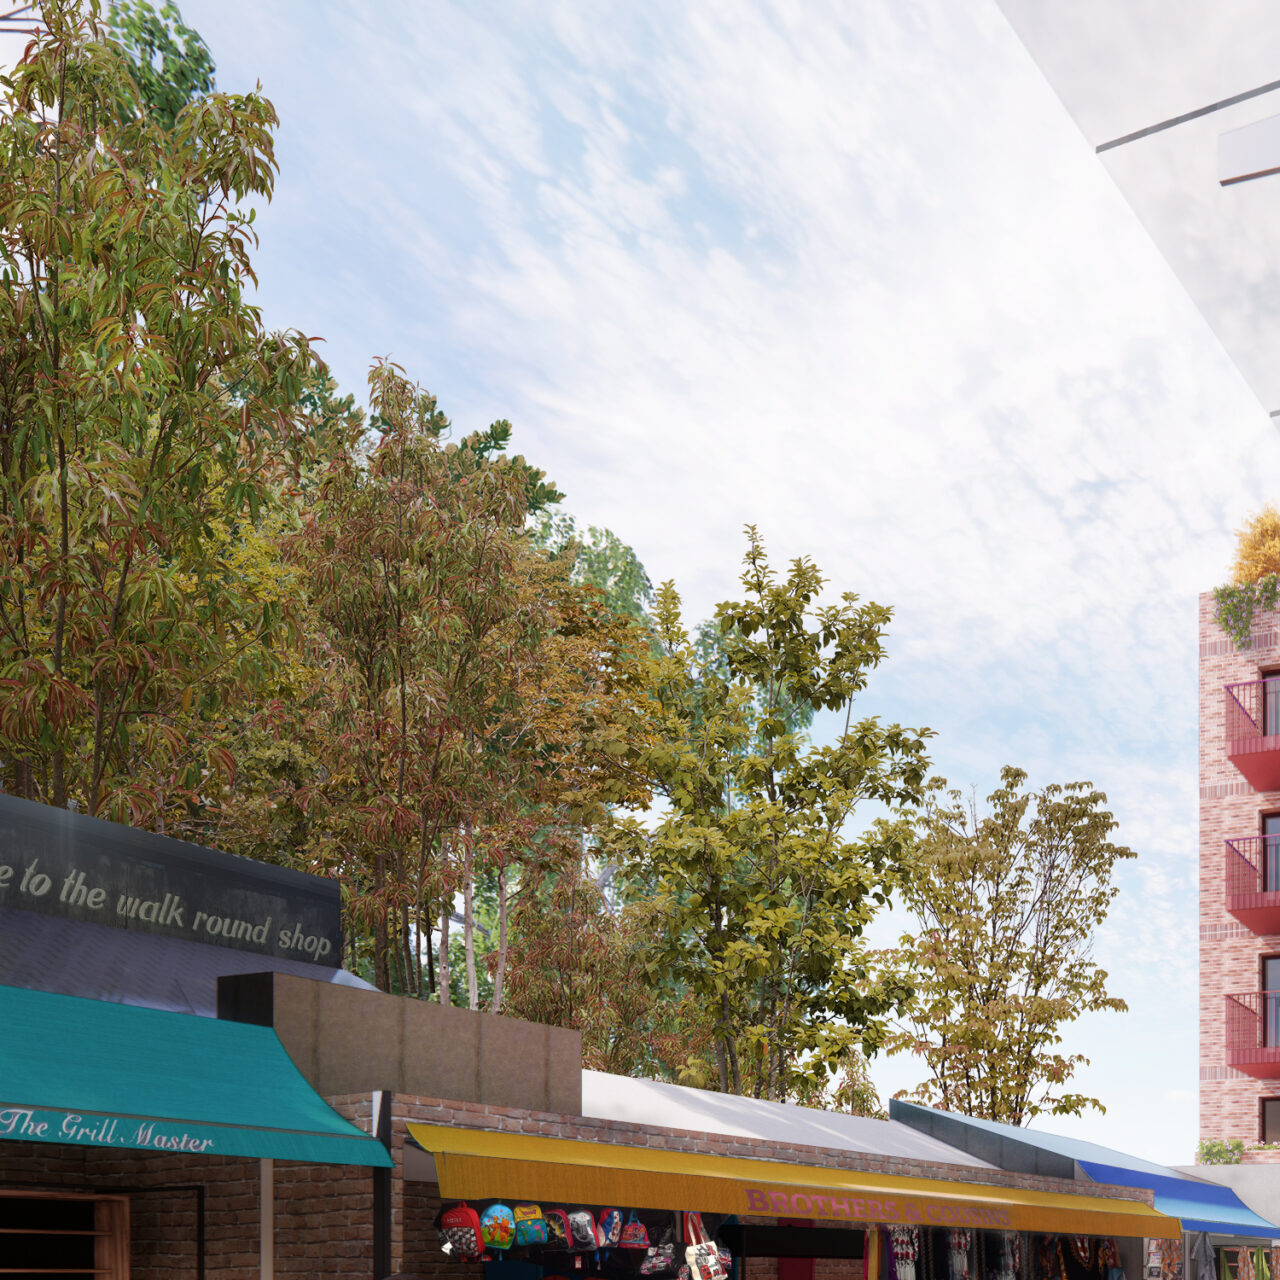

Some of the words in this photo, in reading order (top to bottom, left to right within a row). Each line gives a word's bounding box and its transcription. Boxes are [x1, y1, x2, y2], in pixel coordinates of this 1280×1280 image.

[20, 858, 52, 896] to
[60, 869, 106, 910] the
[116, 892, 185, 928] walk
[192, 911, 272, 944] round
[278, 923, 332, 960] shop
[0, 1109, 50, 1137] The
[58, 1112, 118, 1144] Grill
[120, 1122, 214, 1152] Master
[744, 1188, 899, 1221] BROTHERS
[905, 1202, 921, 1222] &
[926, 1203, 1012, 1227] COUSINS
